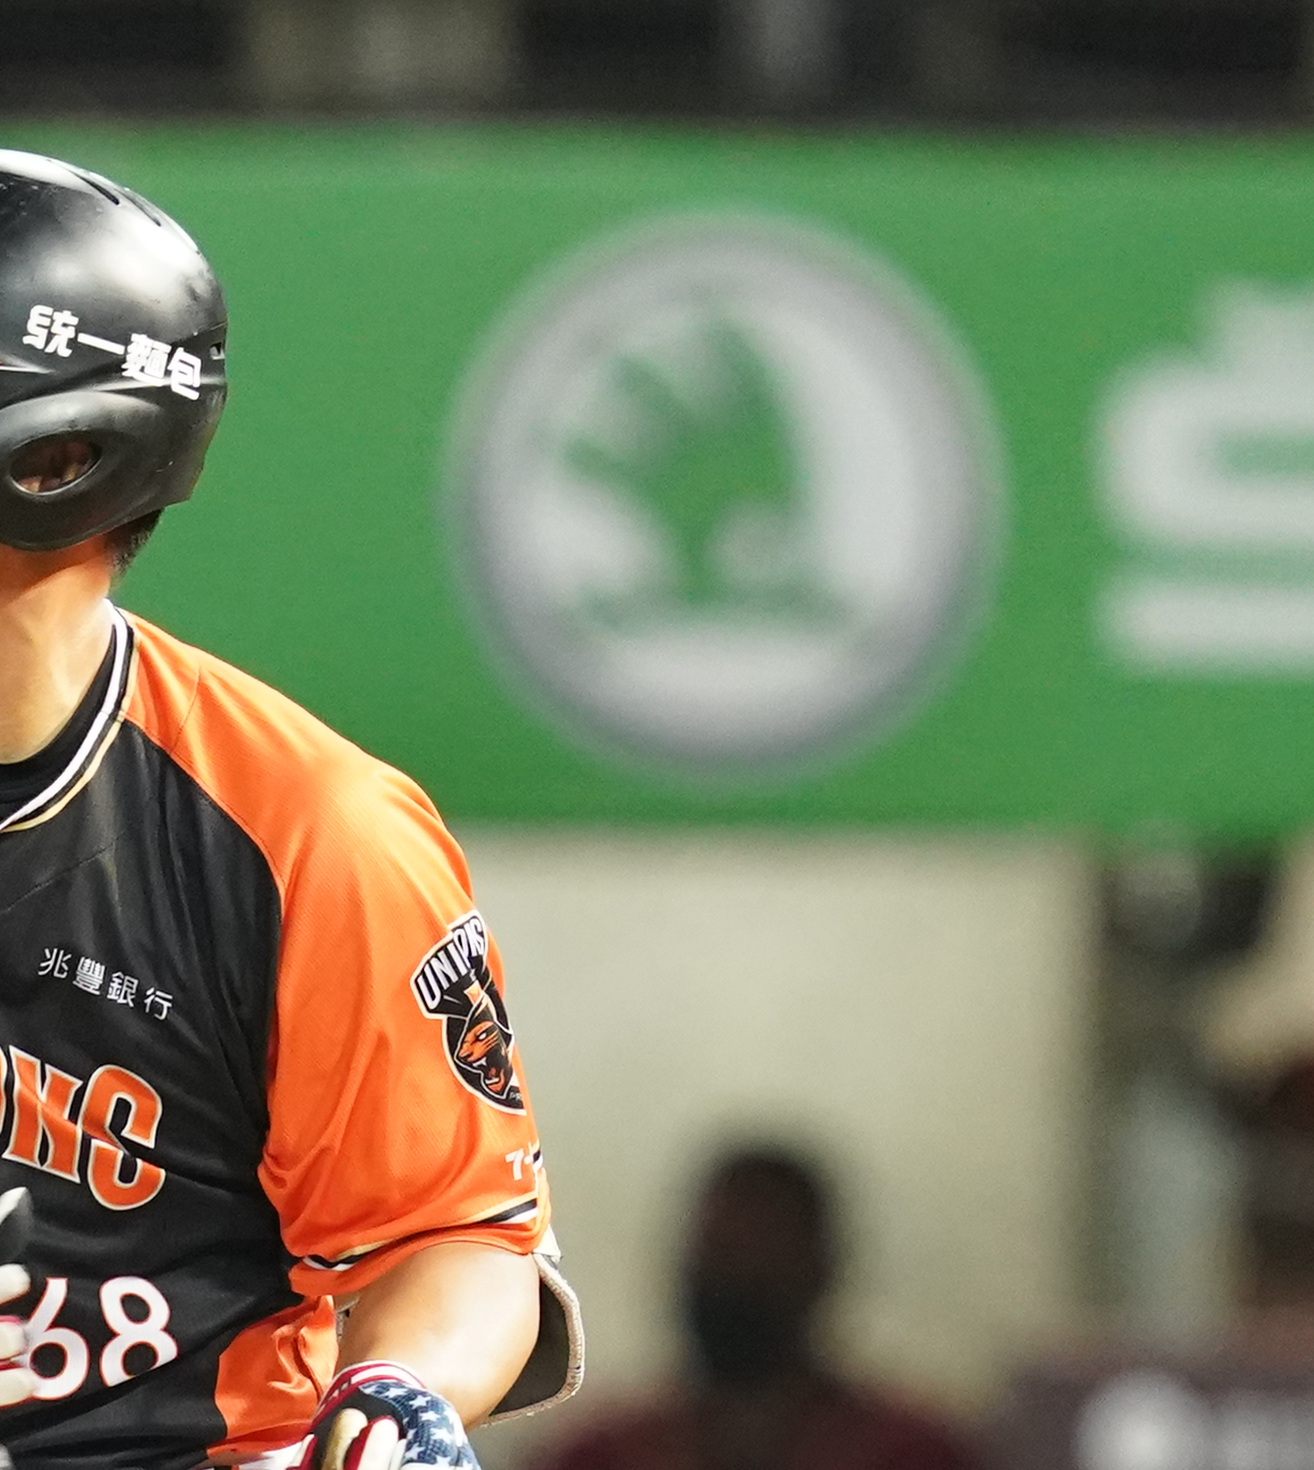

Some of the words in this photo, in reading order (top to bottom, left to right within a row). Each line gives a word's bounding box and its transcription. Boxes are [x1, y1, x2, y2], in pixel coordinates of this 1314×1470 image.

[38, 948, 173, 1020] 兆豐銀行
[22, 1275, 179, 1401] 68
